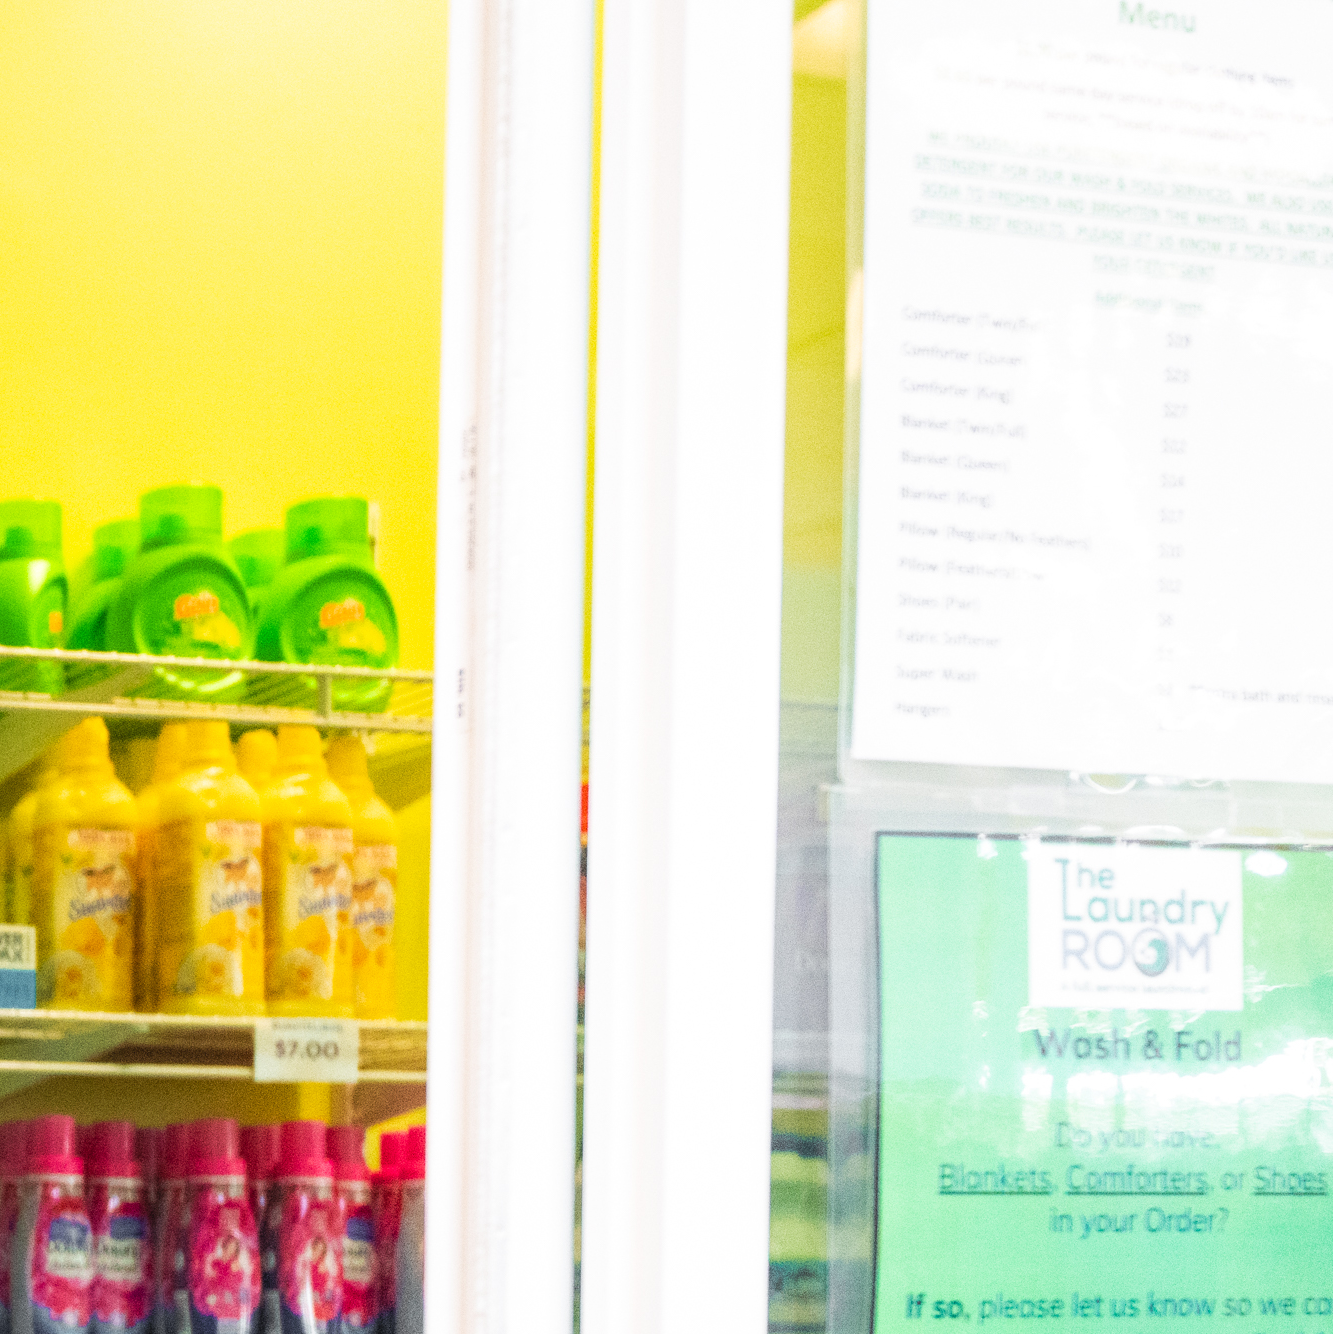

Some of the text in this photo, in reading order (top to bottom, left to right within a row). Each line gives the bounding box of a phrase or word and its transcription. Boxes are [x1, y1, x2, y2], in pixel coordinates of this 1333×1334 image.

[1118, 1, 1197, 33] Menu
[1054, 858, 1116, 890] The
[1061, 889, 1230, 934] Laundry
[1061, 929, 1213, 977] ROOM
[275, 1039, 339, 1060] $7.00
[1033, 1029, 1243, 1063] Wash & Fold
[1221, 1172, 1245, 1190] or
[1253, 1165, 1329, 1194] Shoes
[1050, 1208, 1228, 1238] in your Order?
[906, 1294, 924, 1319] If
[978, 1293, 1064, 1323] please
[1071, 1293, 1102, 1318] let
[1110, 1298, 1140, 1318] us
[1146, 1292, 1215, 1317] know
[1222, 1296, 1252, 1317] so
[1258, 1295, 1297, 1316] we
